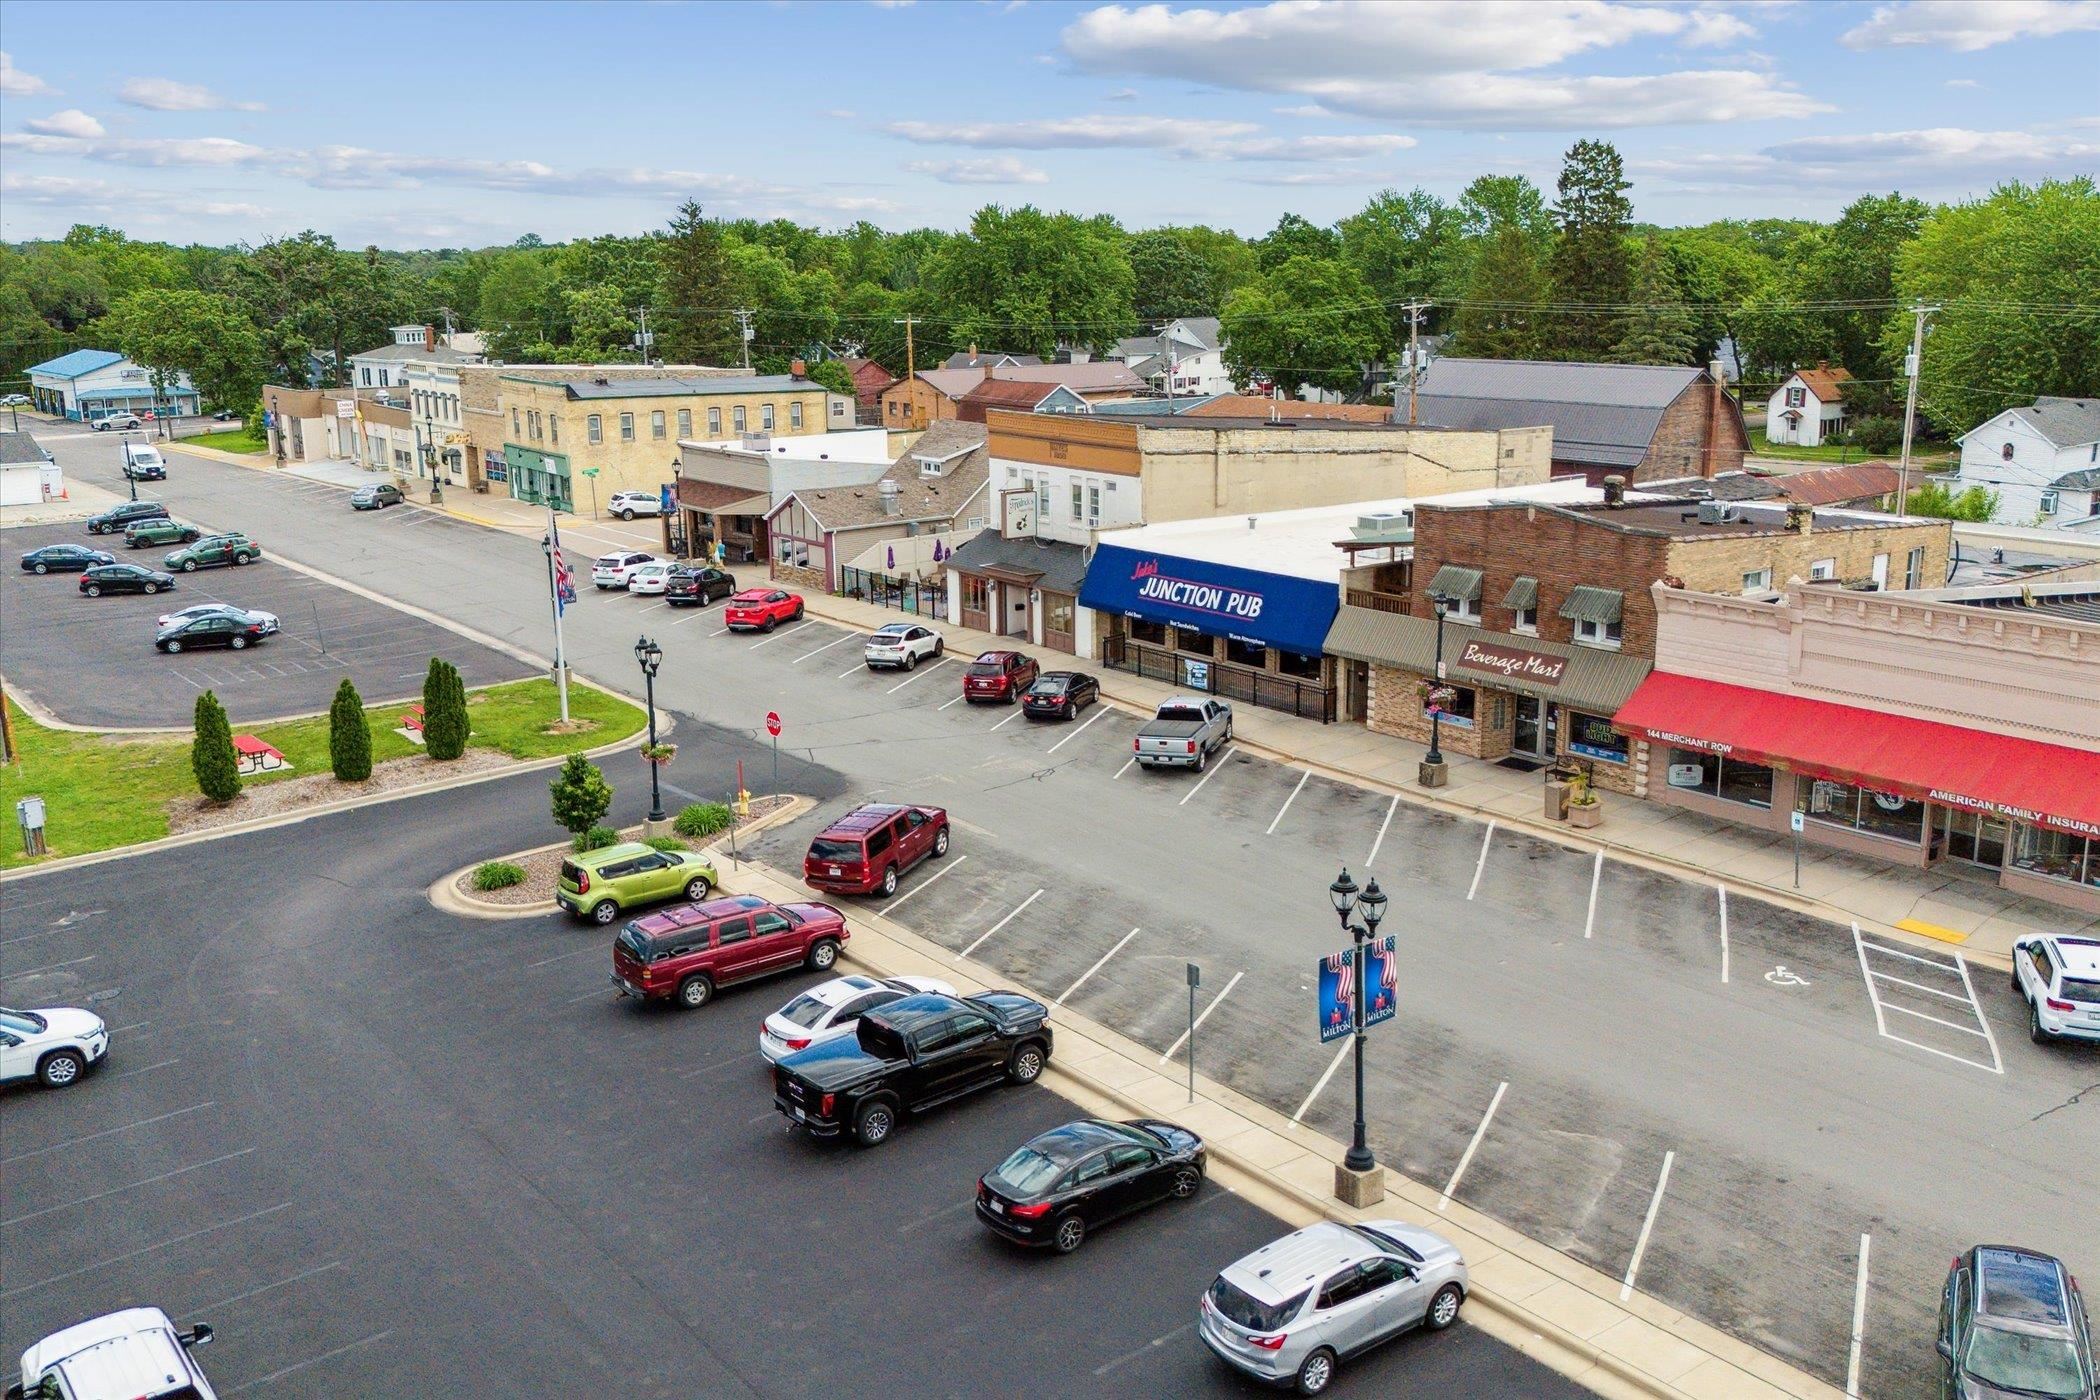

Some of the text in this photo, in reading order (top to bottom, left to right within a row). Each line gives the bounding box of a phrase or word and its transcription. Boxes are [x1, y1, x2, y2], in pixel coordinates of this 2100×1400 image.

[1140, 577, 1264, 618] JUNCTION PUB
[1464, 644, 1524, 675] Beverage
[1523, 656, 1563, 678] Mart
[767, 717, 781, 729] STOP
[1647, 728, 1732, 753] 144 MERCHANT ROW
[1929, 789, 2100, 836] AMERICAN FAMILY INSURA
[1366, 1003, 1395, 1023] MILTON
[1322, 1018, 1352, 1038] MILTON
